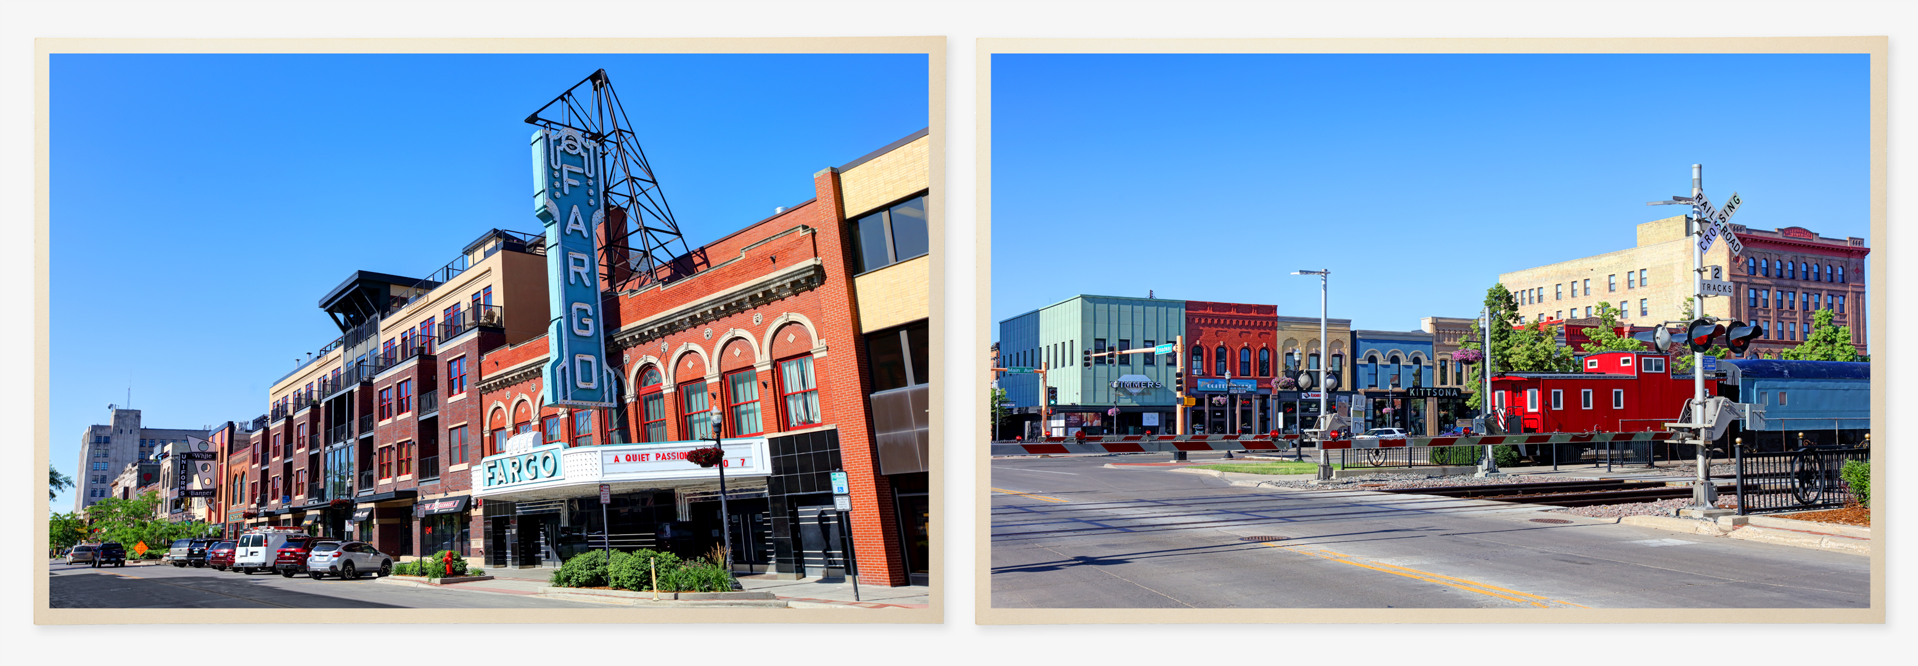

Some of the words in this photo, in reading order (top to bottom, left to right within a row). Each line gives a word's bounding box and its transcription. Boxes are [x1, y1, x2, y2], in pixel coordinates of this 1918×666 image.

[1699, 195, 1741, 251] CROSSING
[561, 163, 598, 390] FARGO
[1713, 267, 1720, 279] 2
[1701, 282, 1733, 293] TRACKS
[1409, 388, 1458, 397] KITTSONA
[192, 452, 213, 460] White
[614, 455, 620, 463] A
[625, 453, 651, 462] QUIET
[740, 458, 746, 467] 7
[485, 450, 558, 487] FARGO
[179, 453, 187, 497] UNIFORMS
[189, 489, 214, 497] Banner
